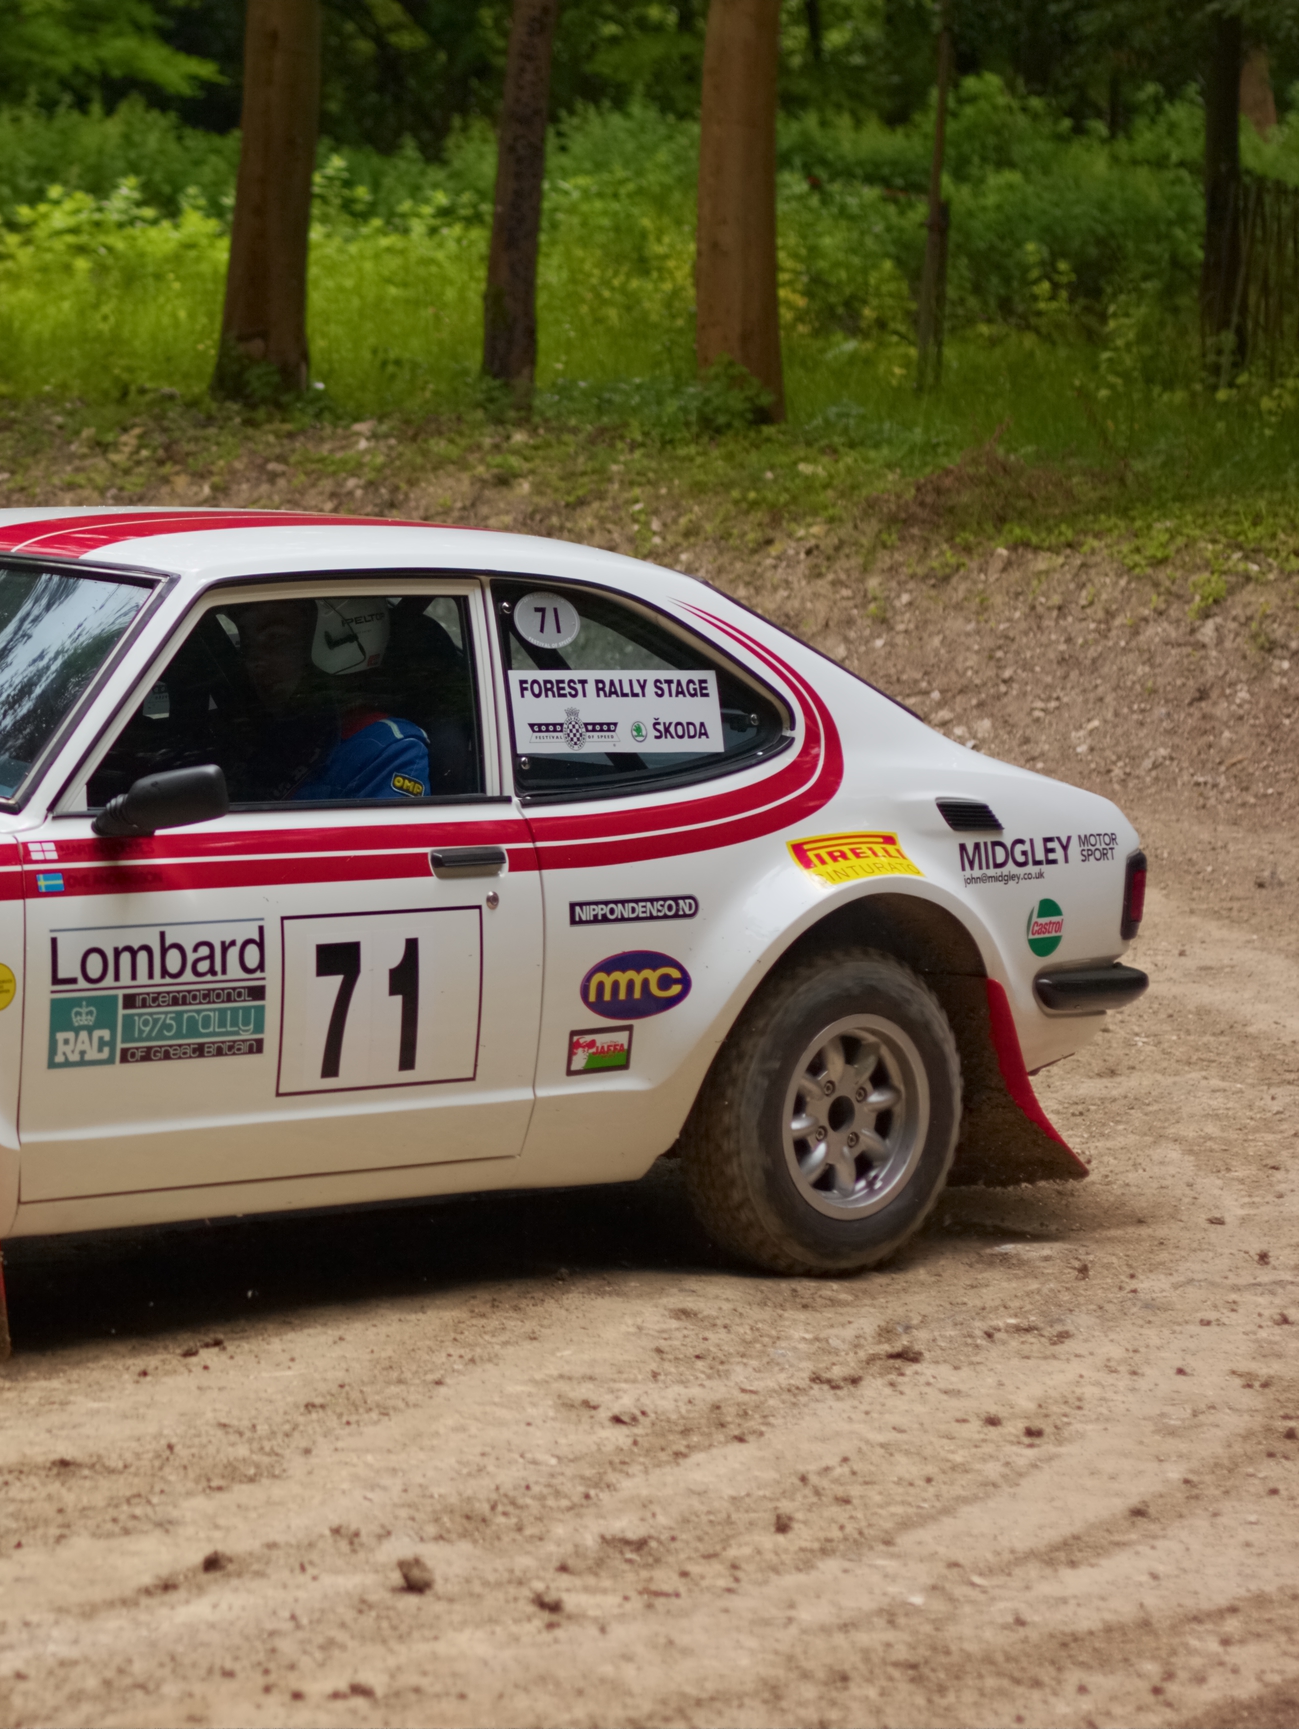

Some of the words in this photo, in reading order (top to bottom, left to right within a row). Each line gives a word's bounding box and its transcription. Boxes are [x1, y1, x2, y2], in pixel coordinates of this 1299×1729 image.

[534, 607, 561, 634] 71
[518, 679, 588, 698] FOREST
[594, 679, 648, 698] RALLY
[653, 679, 710, 698] STAGE
[653, 718, 710, 739] ŠKODA
[394, 776, 423, 794] OMP
[1077, 833, 1119, 848] MOTOR
[791, 834, 908, 870] PIRELLI
[958, 835, 1072, 872] MIDGLEY
[1080, 847, 1115, 862] SPORT
[963, 869, 1045, 888] john@midgley.co.uk
[575, 900, 677, 922] NIPPONDENSO
[678, 899, 696, 915] ND
[1031, 918, 1064, 936] Castrol
[50, 925, 266, 986] Lombard
[315, 937, 419, 1079] 71
[134, 1013, 177, 1038] 1975
[54, 1029, 111, 1063] RAC
[592, 1043, 625, 1056] JAFFA
